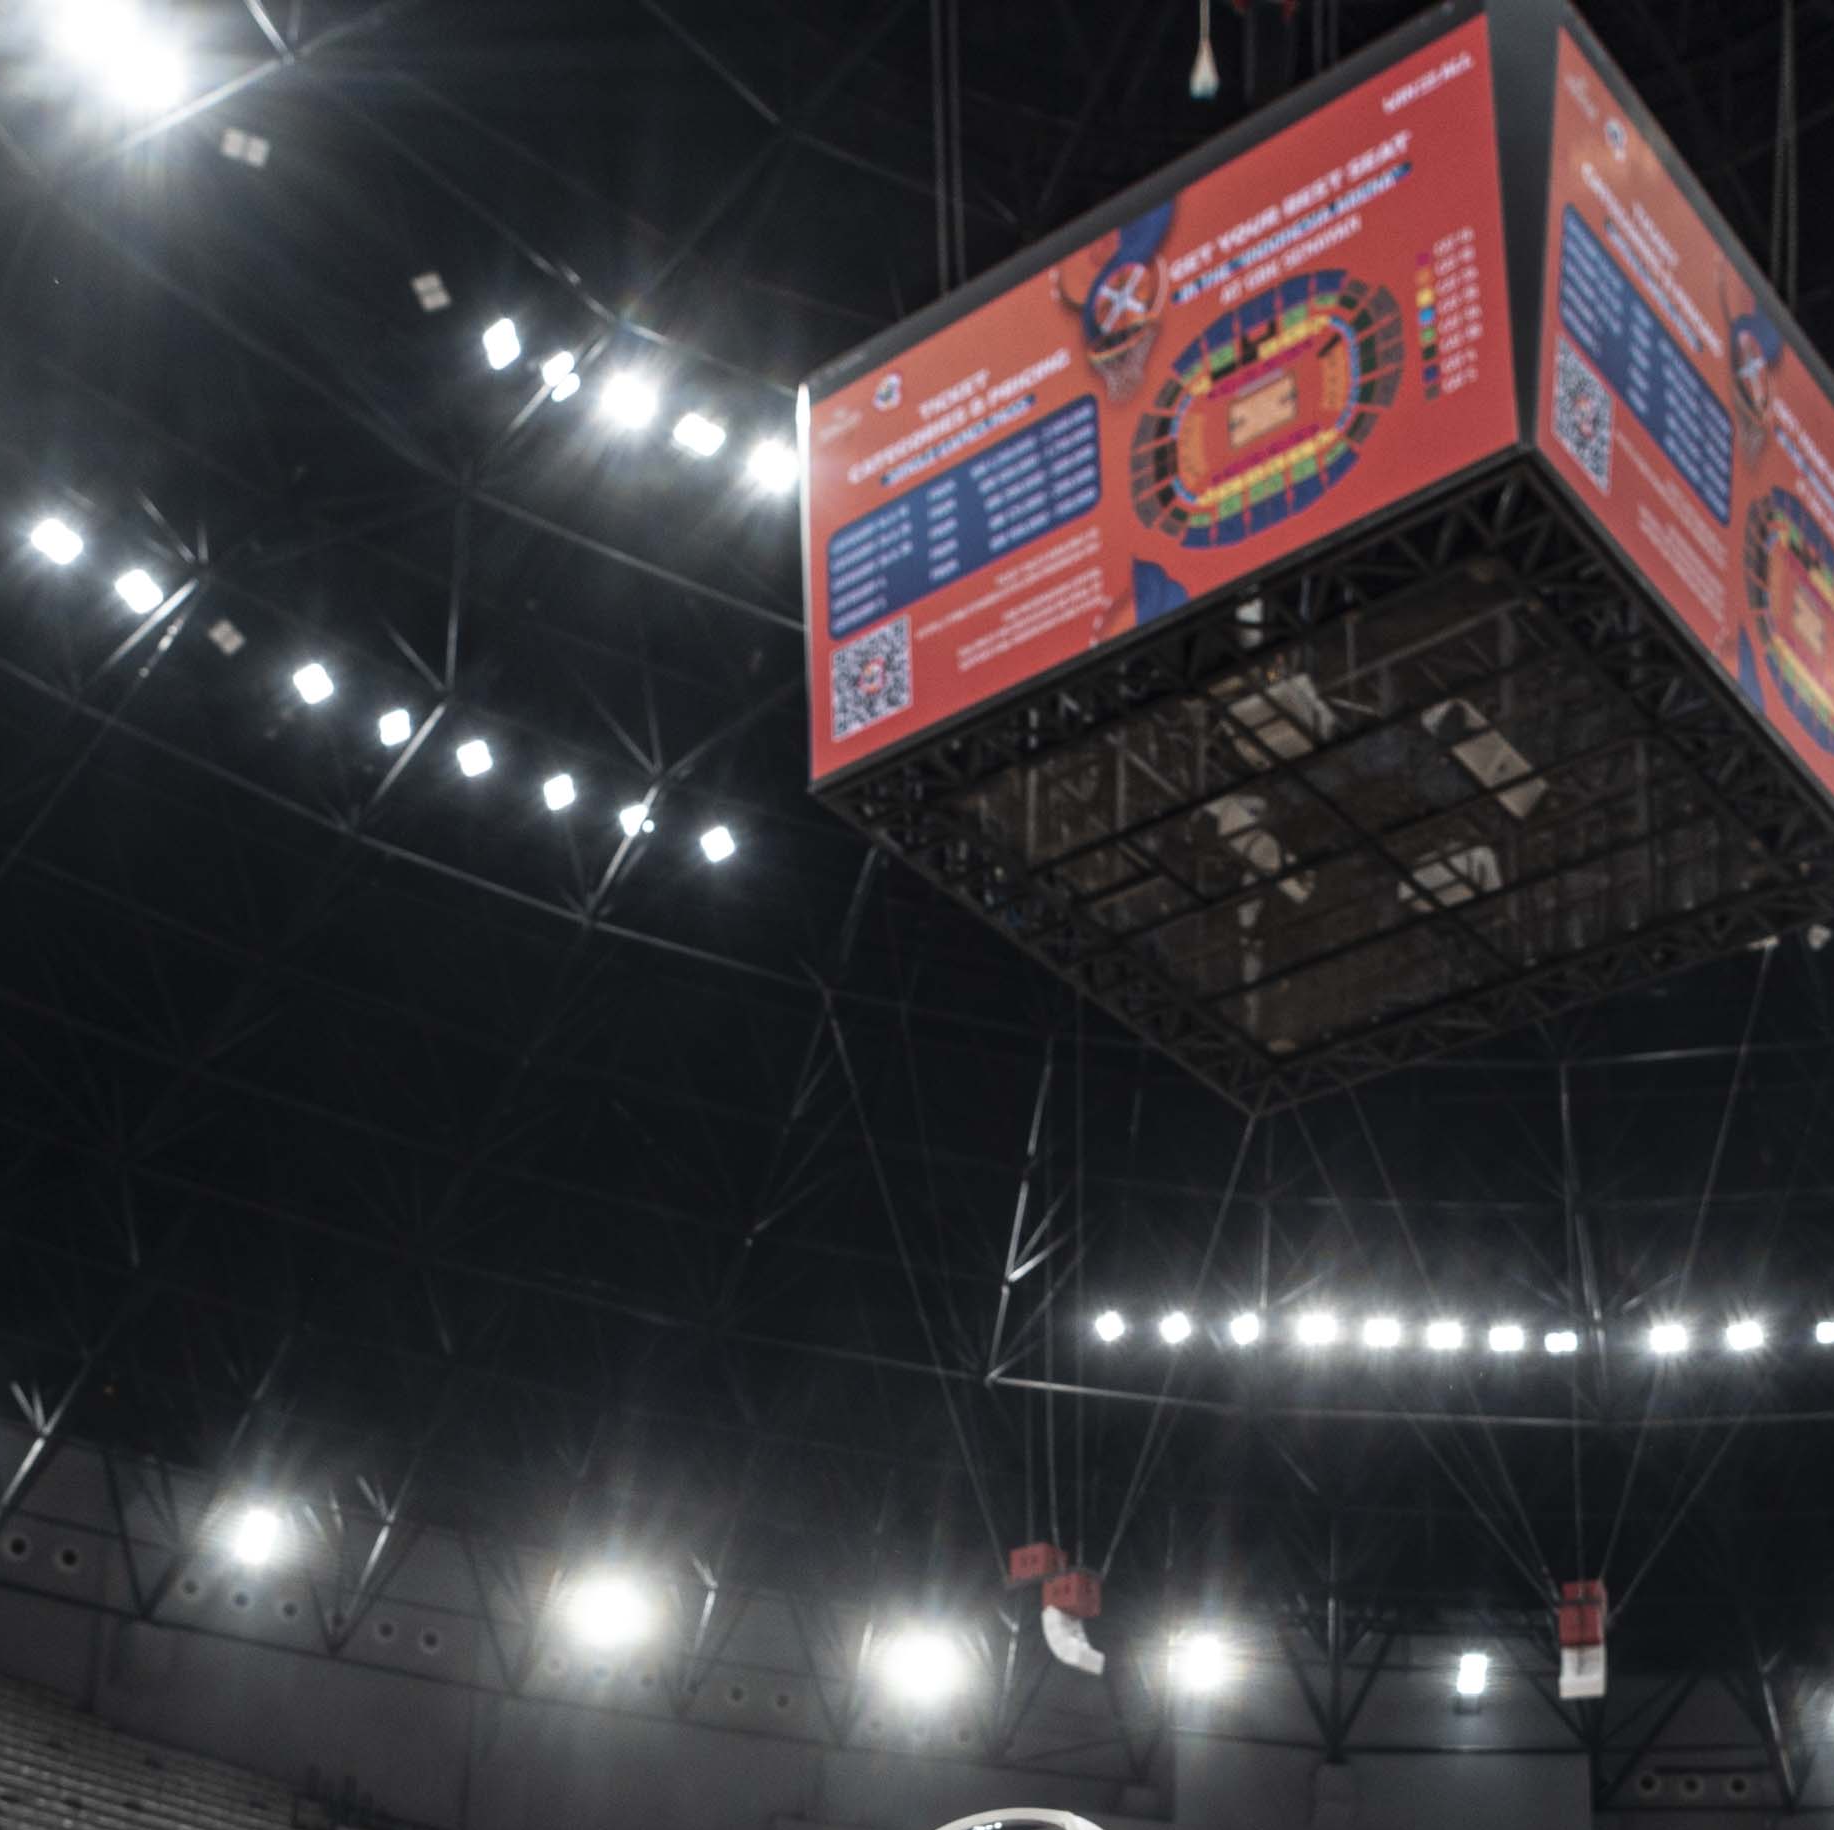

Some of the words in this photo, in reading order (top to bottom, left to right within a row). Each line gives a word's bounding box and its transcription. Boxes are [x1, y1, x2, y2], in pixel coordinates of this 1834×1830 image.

[1169, 241, 1214, 281] GET
[1216, 205, 1280, 252] YOUR
[1282, 167, 1343, 216] BEST
[1345, 129, 1412, 181] SEAT
